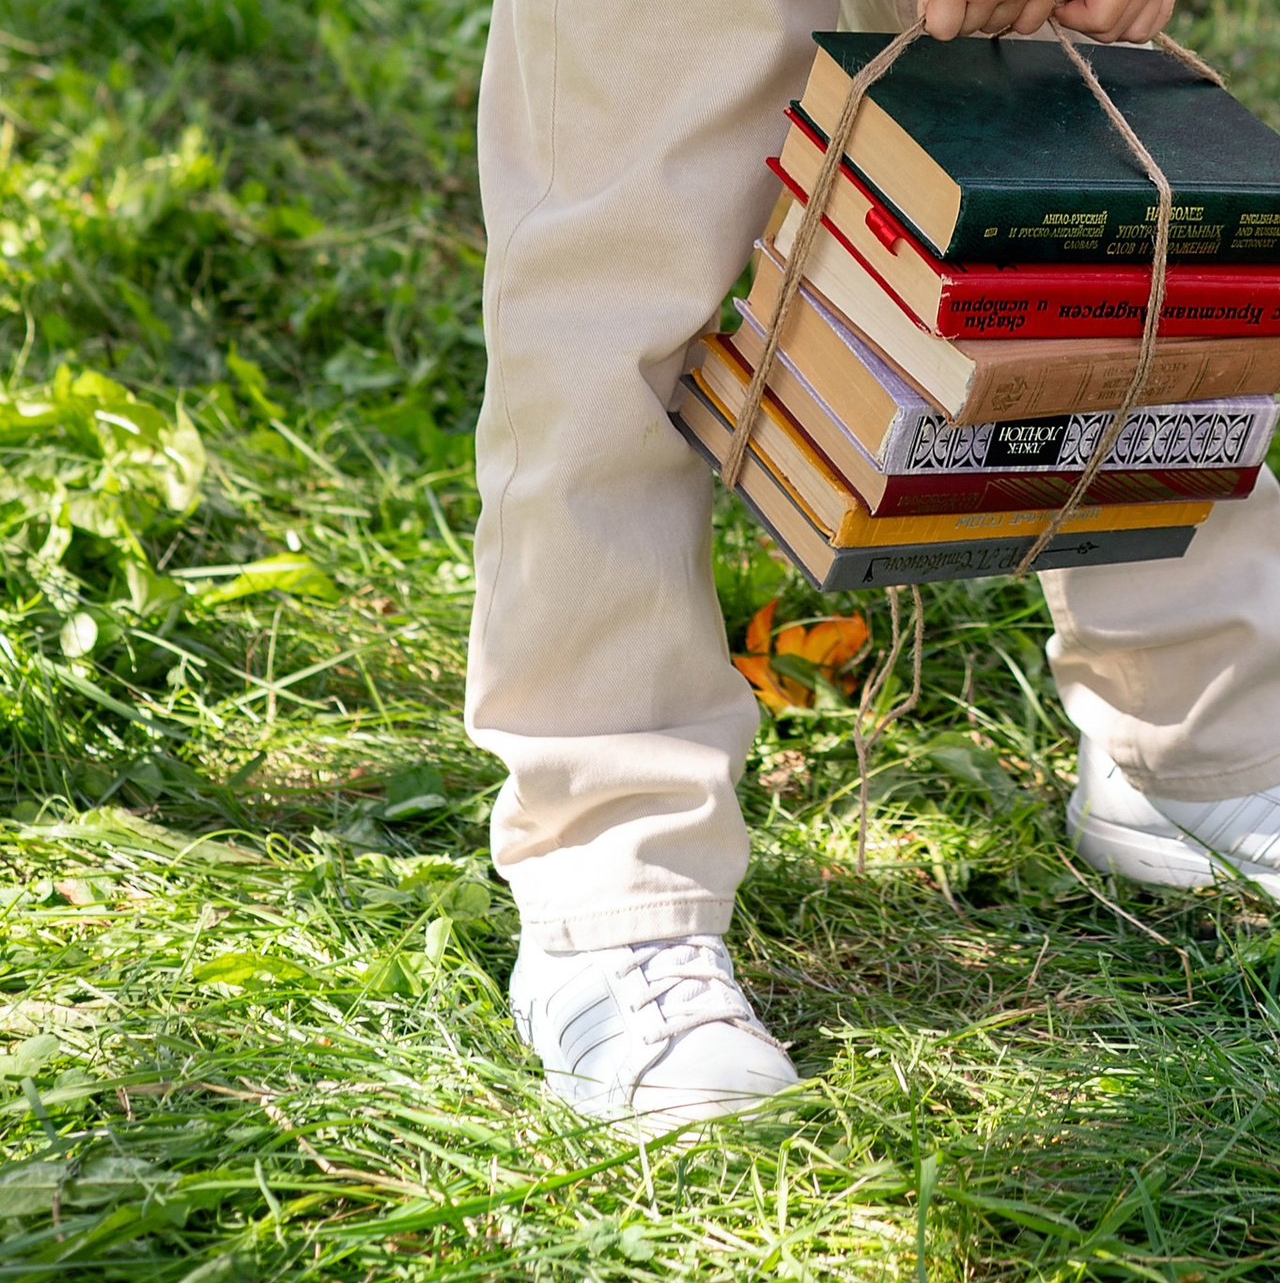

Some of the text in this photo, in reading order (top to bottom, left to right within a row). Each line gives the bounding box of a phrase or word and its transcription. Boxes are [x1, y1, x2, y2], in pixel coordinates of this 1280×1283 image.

[1042, 210, 1109, 225] АНГЛО-РУССКИЙ
[1008, 227, 1018, 238] И
[1235, 226, 1254, 237] AND
[1063, 240, 1099, 250] СЛОВАРЬ
[1106, 242, 1136, 255] СЛОВ
[1138, 242, 1149, 255] И
[1230, 238, 1278, 249] DICTIONARY
[950, 295, 1048, 316] и истории
[1162, 302, 1265, 324] Кристиан
[964, 309, 1026, 332] сказки
[998, 426, 1064, 442] ЛОНДОН
[1007, 441, 1046, 454] ДЖЕК
